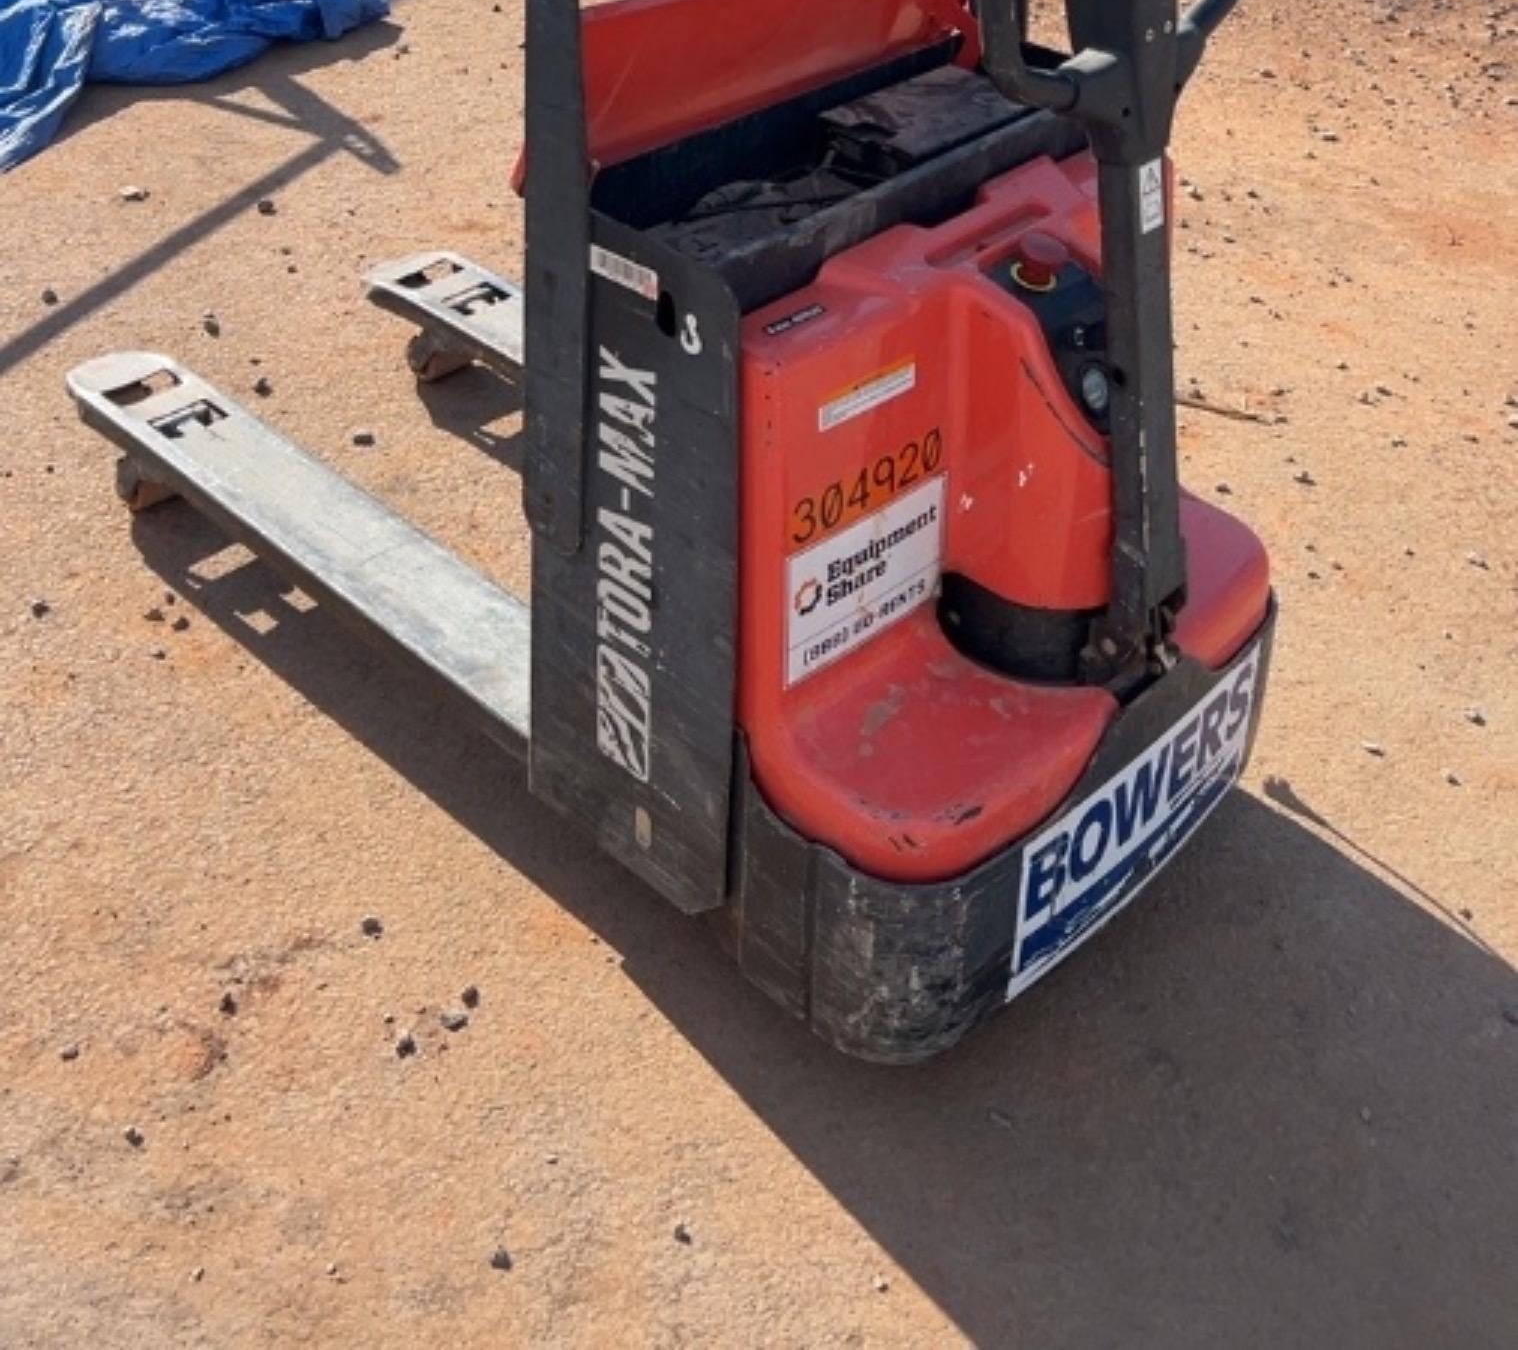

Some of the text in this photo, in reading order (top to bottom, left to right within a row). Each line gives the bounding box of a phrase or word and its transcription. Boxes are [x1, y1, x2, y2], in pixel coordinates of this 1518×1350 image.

[597, 345, 657, 658] TORA-MAX
[792, 426, 942, 543] 304920
[826, 560, 886, 608] Share
[827, 504, 936, 583] Equipment
[1025, 665, 1249, 921] BOWERS
